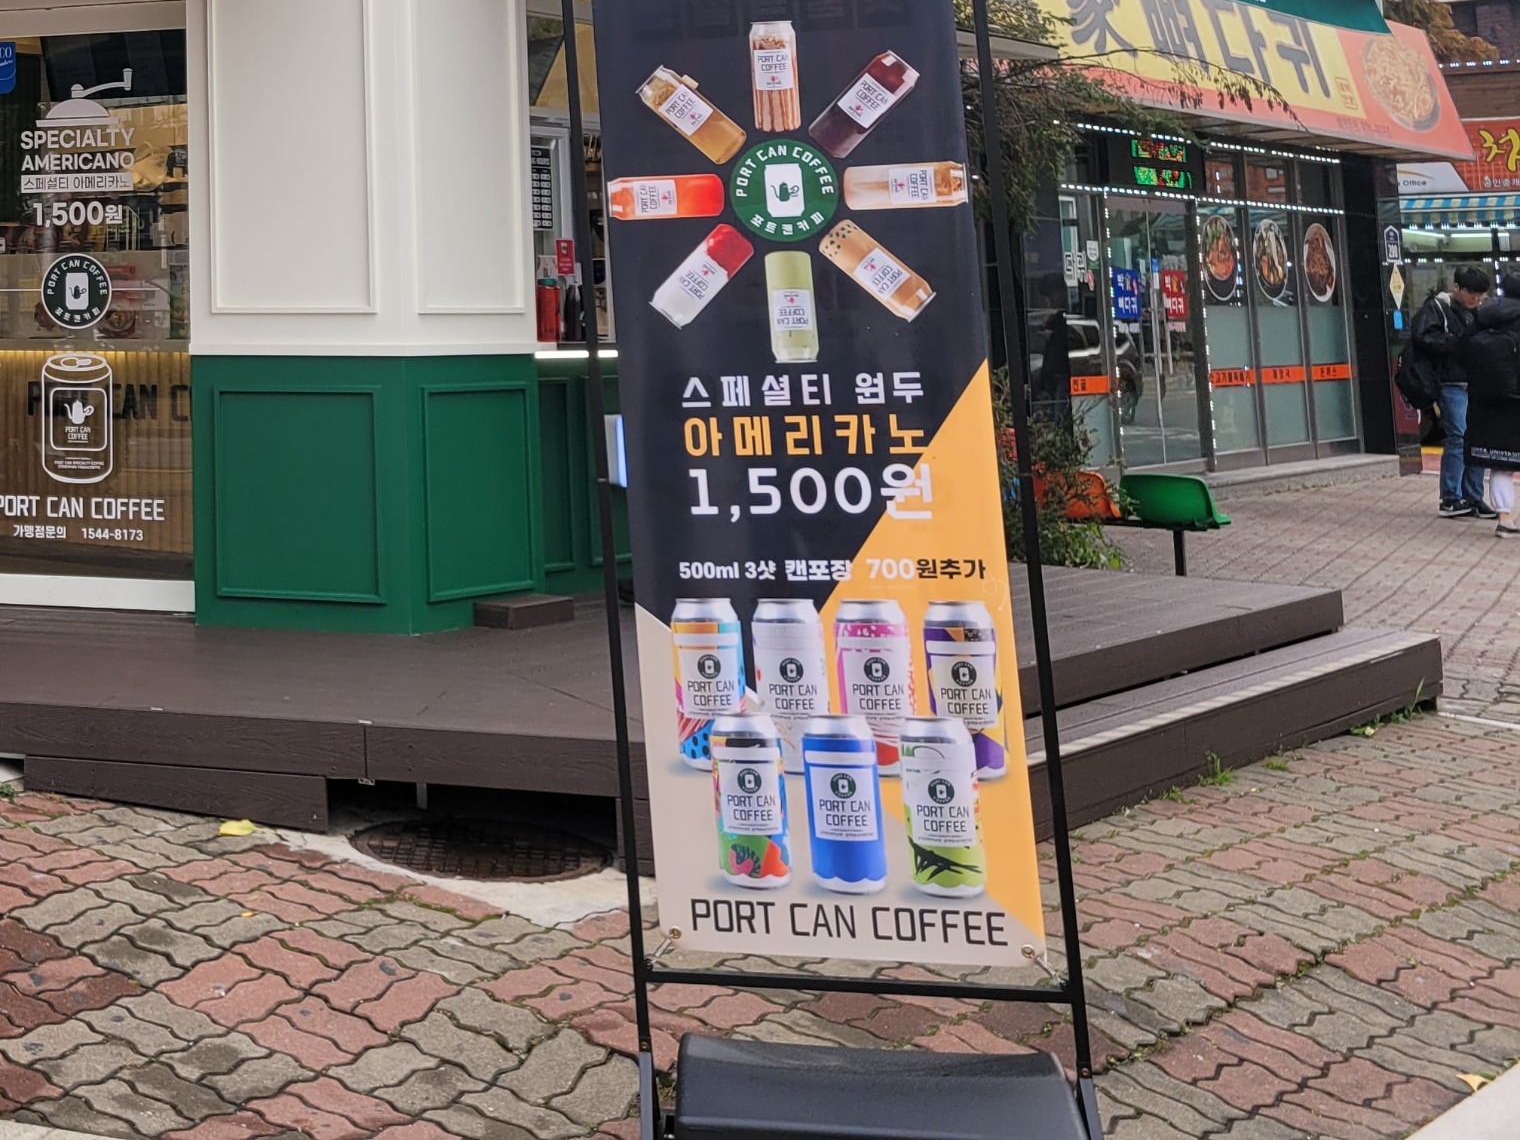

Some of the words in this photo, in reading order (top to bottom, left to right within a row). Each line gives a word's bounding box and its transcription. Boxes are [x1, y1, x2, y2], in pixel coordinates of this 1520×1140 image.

[757, 55, 775, 63] PORT
[761, 63, 787, 71] COFFEE
[856, 89, 881, 110] COFFEE
[674, 97, 695, 119] COFFEE
[20, 128, 135, 150] SPECIALTY
[21, 152, 135, 172] AMERICANO
[736, 158, 757, 197] PORT
[756, 145, 787, 161] CAN
[792, 147, 834, 195] COFFEE
[24, 176, 69, 191] 스페셜티
[73, 175, 131, 190] 아메리카노
[649, 185, 657, 210] COFFEE
[33, 201, 124, 228] 1,500원
[750, 212, 825, 235] 포트캔커피
[46, 269, 61, 295] PORT
[60, 259, 81, 270] CAN
[83, 260, 108, 295] COFFEE
[681, 372, 832, 410] 스페셜티
[854, 370, 925, 406] 원두
[682, 413, 930, 458] 아메리카노
[688, 463, 934, 523] 1,500원
[47, 496, 83, 519] CAN
[91, 497, 165, 521] COFFEE
[13, 524, 67, 539] 가맹점문의
[81, 527, 144, 541] 1544-8173
[678, 560, 740, 580] 500ml
[744, 560, 777, 580] 3샷
[785, 558, 853, 582] 캔포장
[866, 558, 986, 581] 700원추가
[688, 681, 712, 693] PORT
[716, 680, 735, 692] CAN
[769, 684, 794, 695] PORT
[798, 684, 817, 695] CAN
[852, 683, 879, 696] PORT
[883, 683, 904, 696] CAN
[940, 687, 967, 701] PORT
[970, 687, 992, 700] CAN
[693, 694, 732, 706] COFFEE
[775, 698, 815, 710] COFFEE
[859, 697, 902, 711] COFFEE
[947, 702, 990, 716] COFFEE
[727, 795, 752, 807] PORT
[757, 795, 776, 807] CAN
[819, 799, 846, 813] PORT
[849, 800, 871, 813] CAN
[733, 810, 773, 821] COFFEE
[916, 804, 944, 818] PORT
[947, 804, 969, 818] CAN
[825, 813, 869, 827] COFFEE
[923, 819, 967, 833] COFFEE
[690, 897, 775, 936] PORT
[789, 902, 856, 940] CAN
[871, 906, 1009, 947] COFFEE
